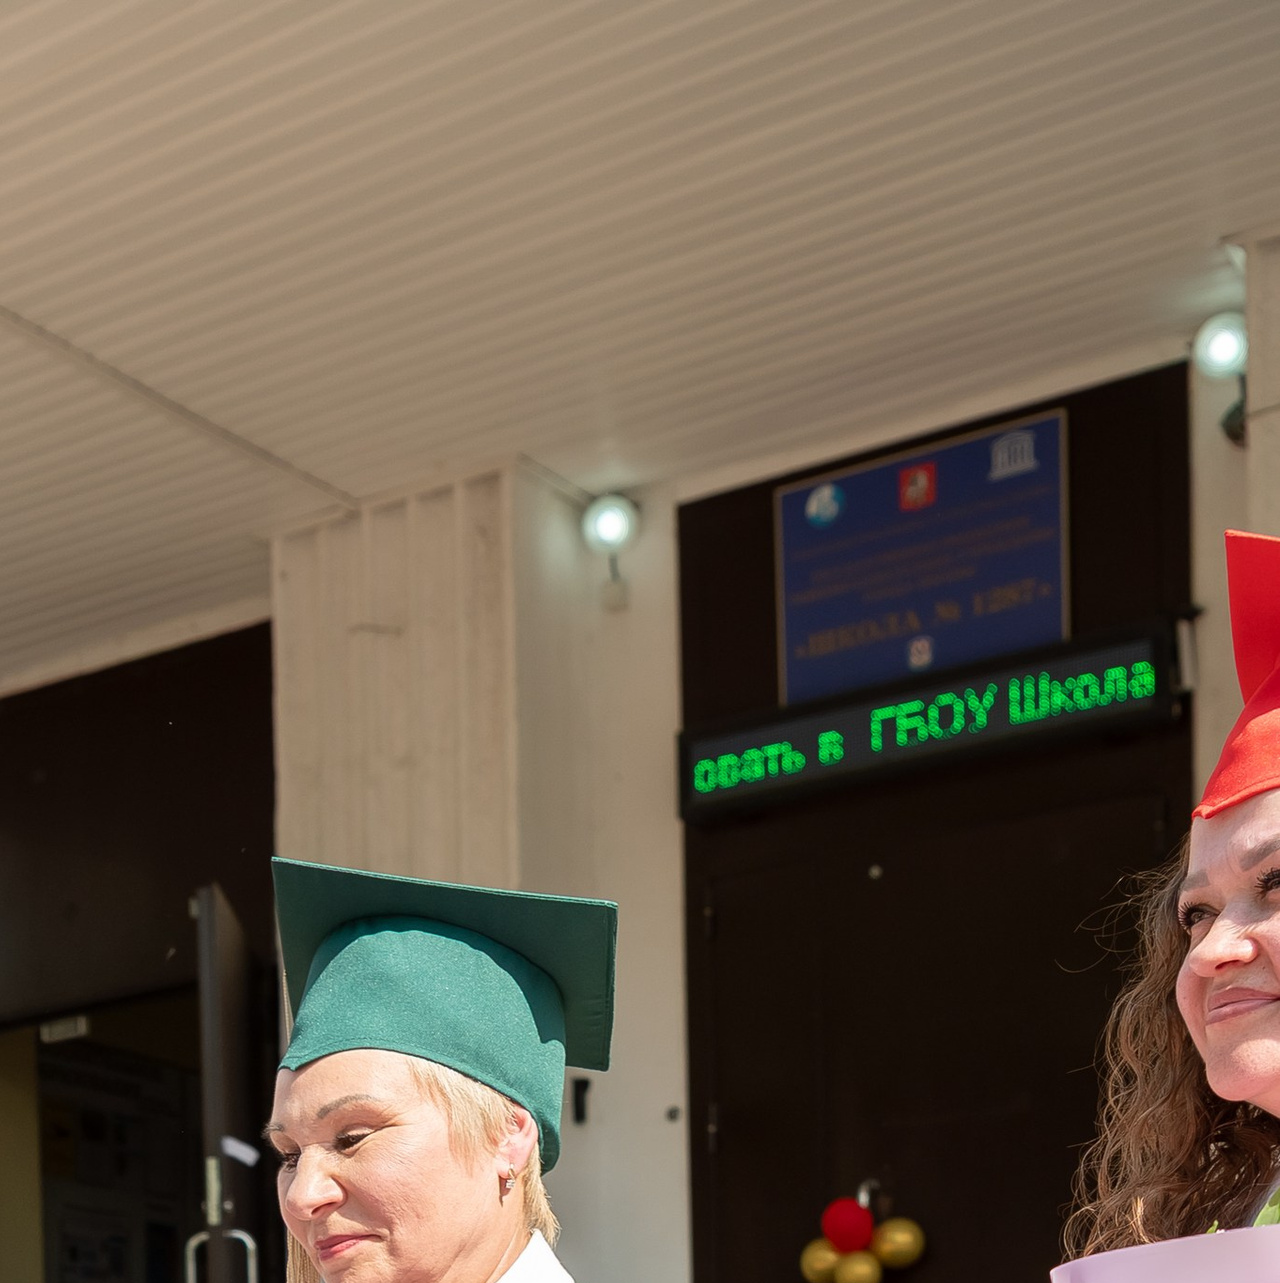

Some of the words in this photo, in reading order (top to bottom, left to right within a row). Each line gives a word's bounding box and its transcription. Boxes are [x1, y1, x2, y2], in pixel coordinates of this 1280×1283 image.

[694, 741, 806, 793] овать
[818, 730, 844, 766] в
[870, 682, 998, 753] ГБОУ
[1008, 661, 1156, 725] Школа
